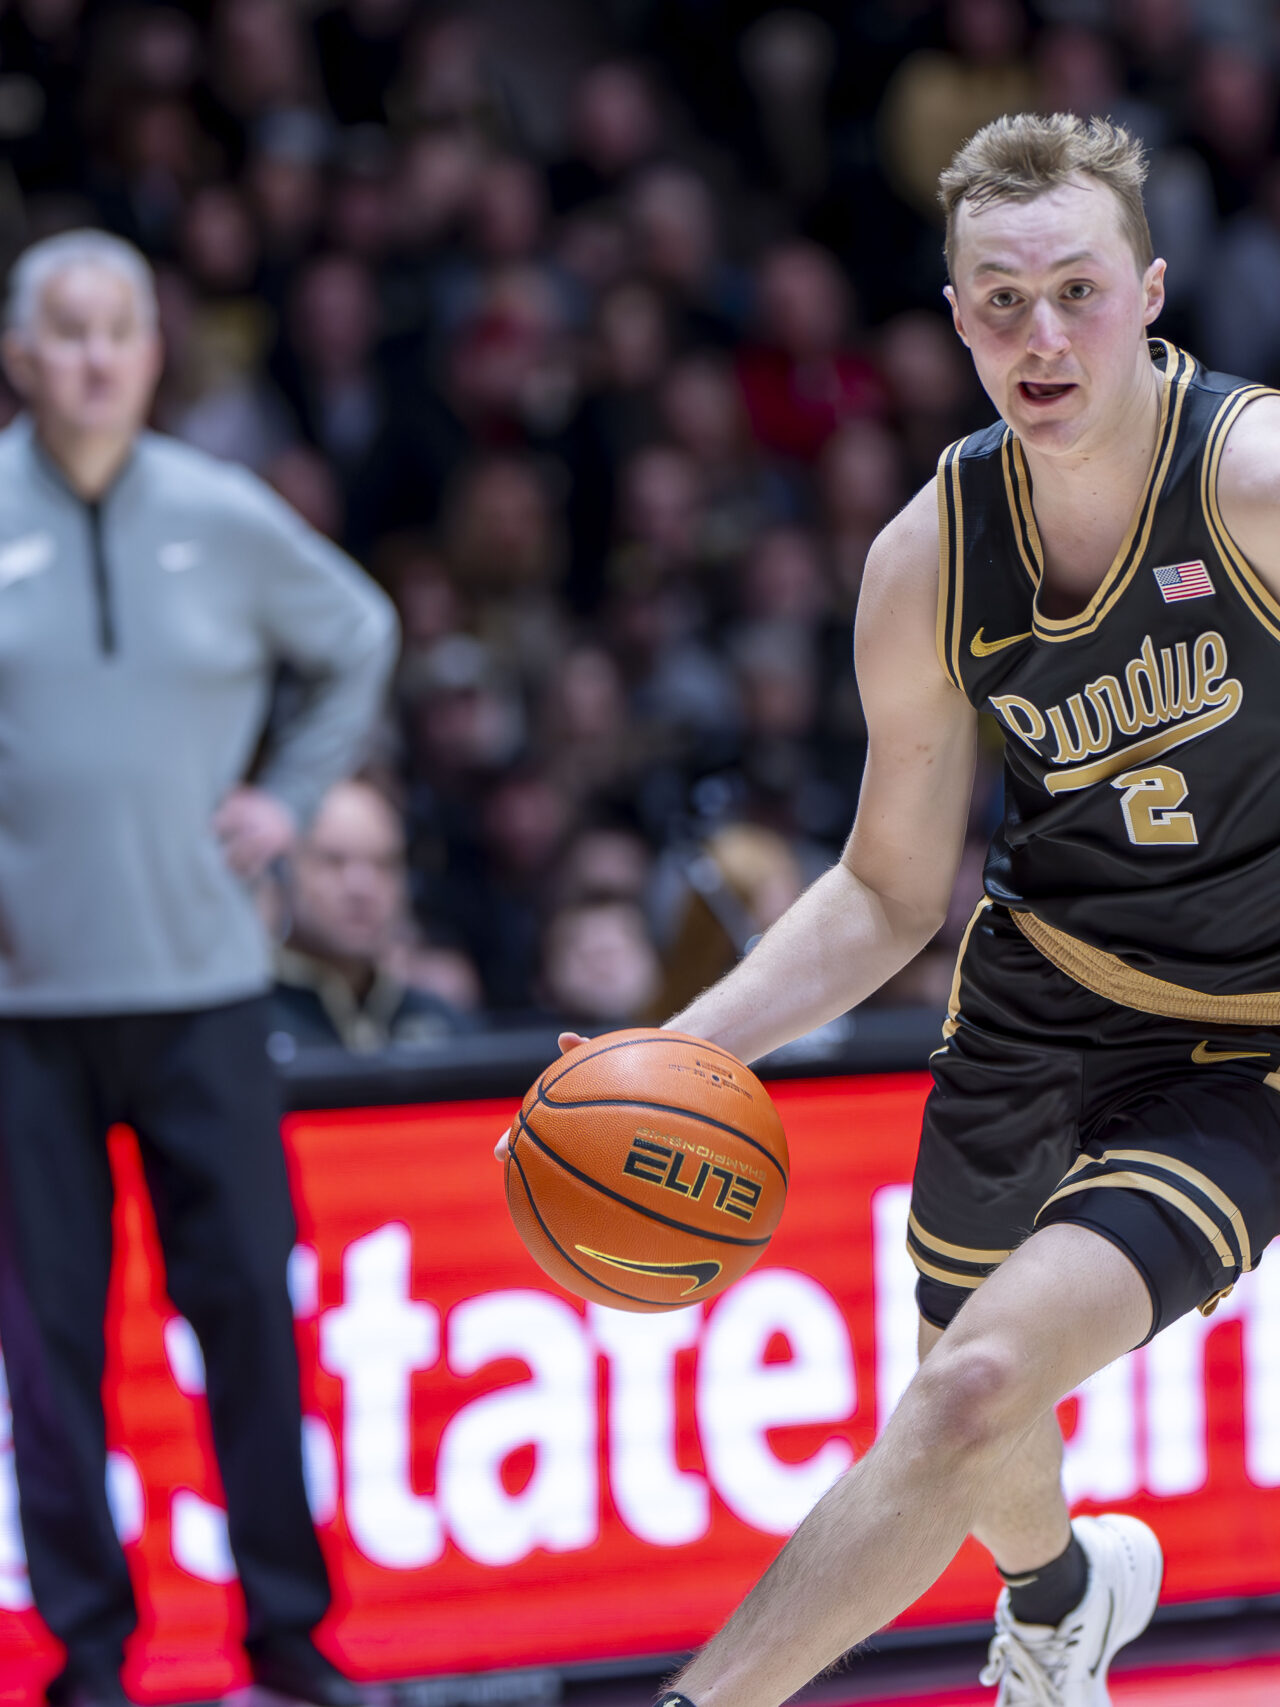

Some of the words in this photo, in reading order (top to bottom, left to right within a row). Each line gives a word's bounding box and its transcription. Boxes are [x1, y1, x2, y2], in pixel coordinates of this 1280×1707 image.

[988, 631, 1243, 797] Purdue
[1110, 764, 1199, 845] 2
[622, 1136, 763, 1223] ELITE
